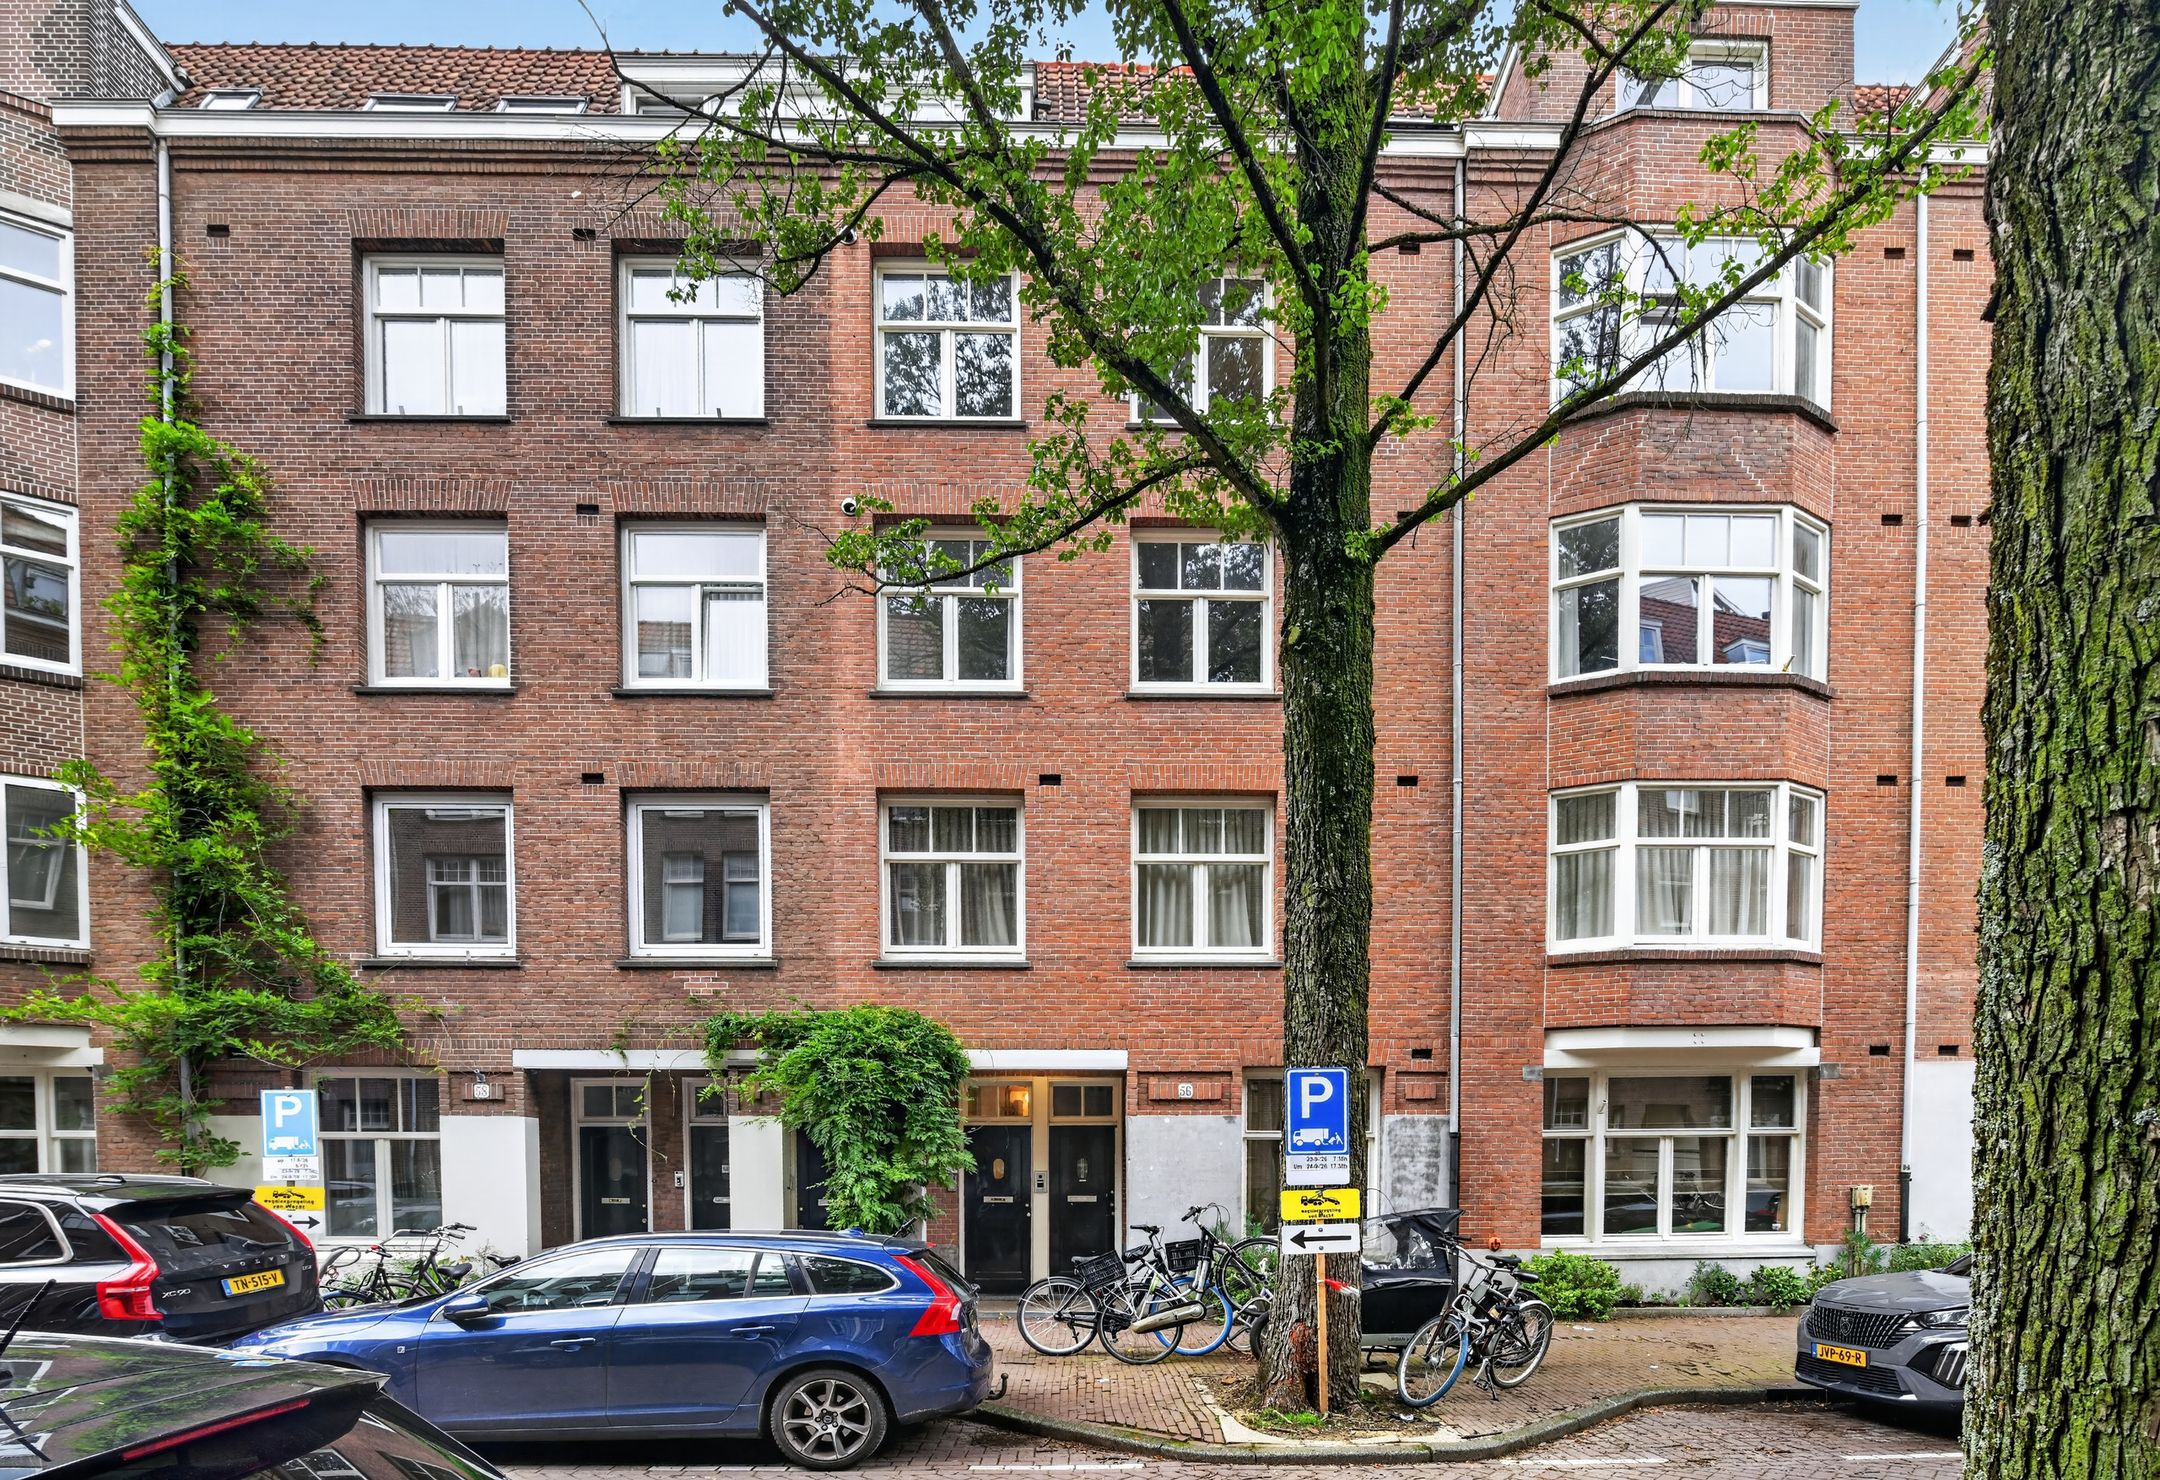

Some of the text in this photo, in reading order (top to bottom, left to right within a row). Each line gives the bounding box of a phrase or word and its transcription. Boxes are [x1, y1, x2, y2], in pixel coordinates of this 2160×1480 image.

[475, 1085, 488, 1097] 58
[1179, 1085, 1191, 1097] 56
[1301, 1076, 1334, 1119] P
[274, 1095, 302, 1128] P
[222, 1254, 287, 1269] VOLVO
[233, 1272, 278, 1291] TN-515-V
[161, 1288, 192, 1299] XC90
[1819, 1347, 1862, 1364] JVP-69-R
